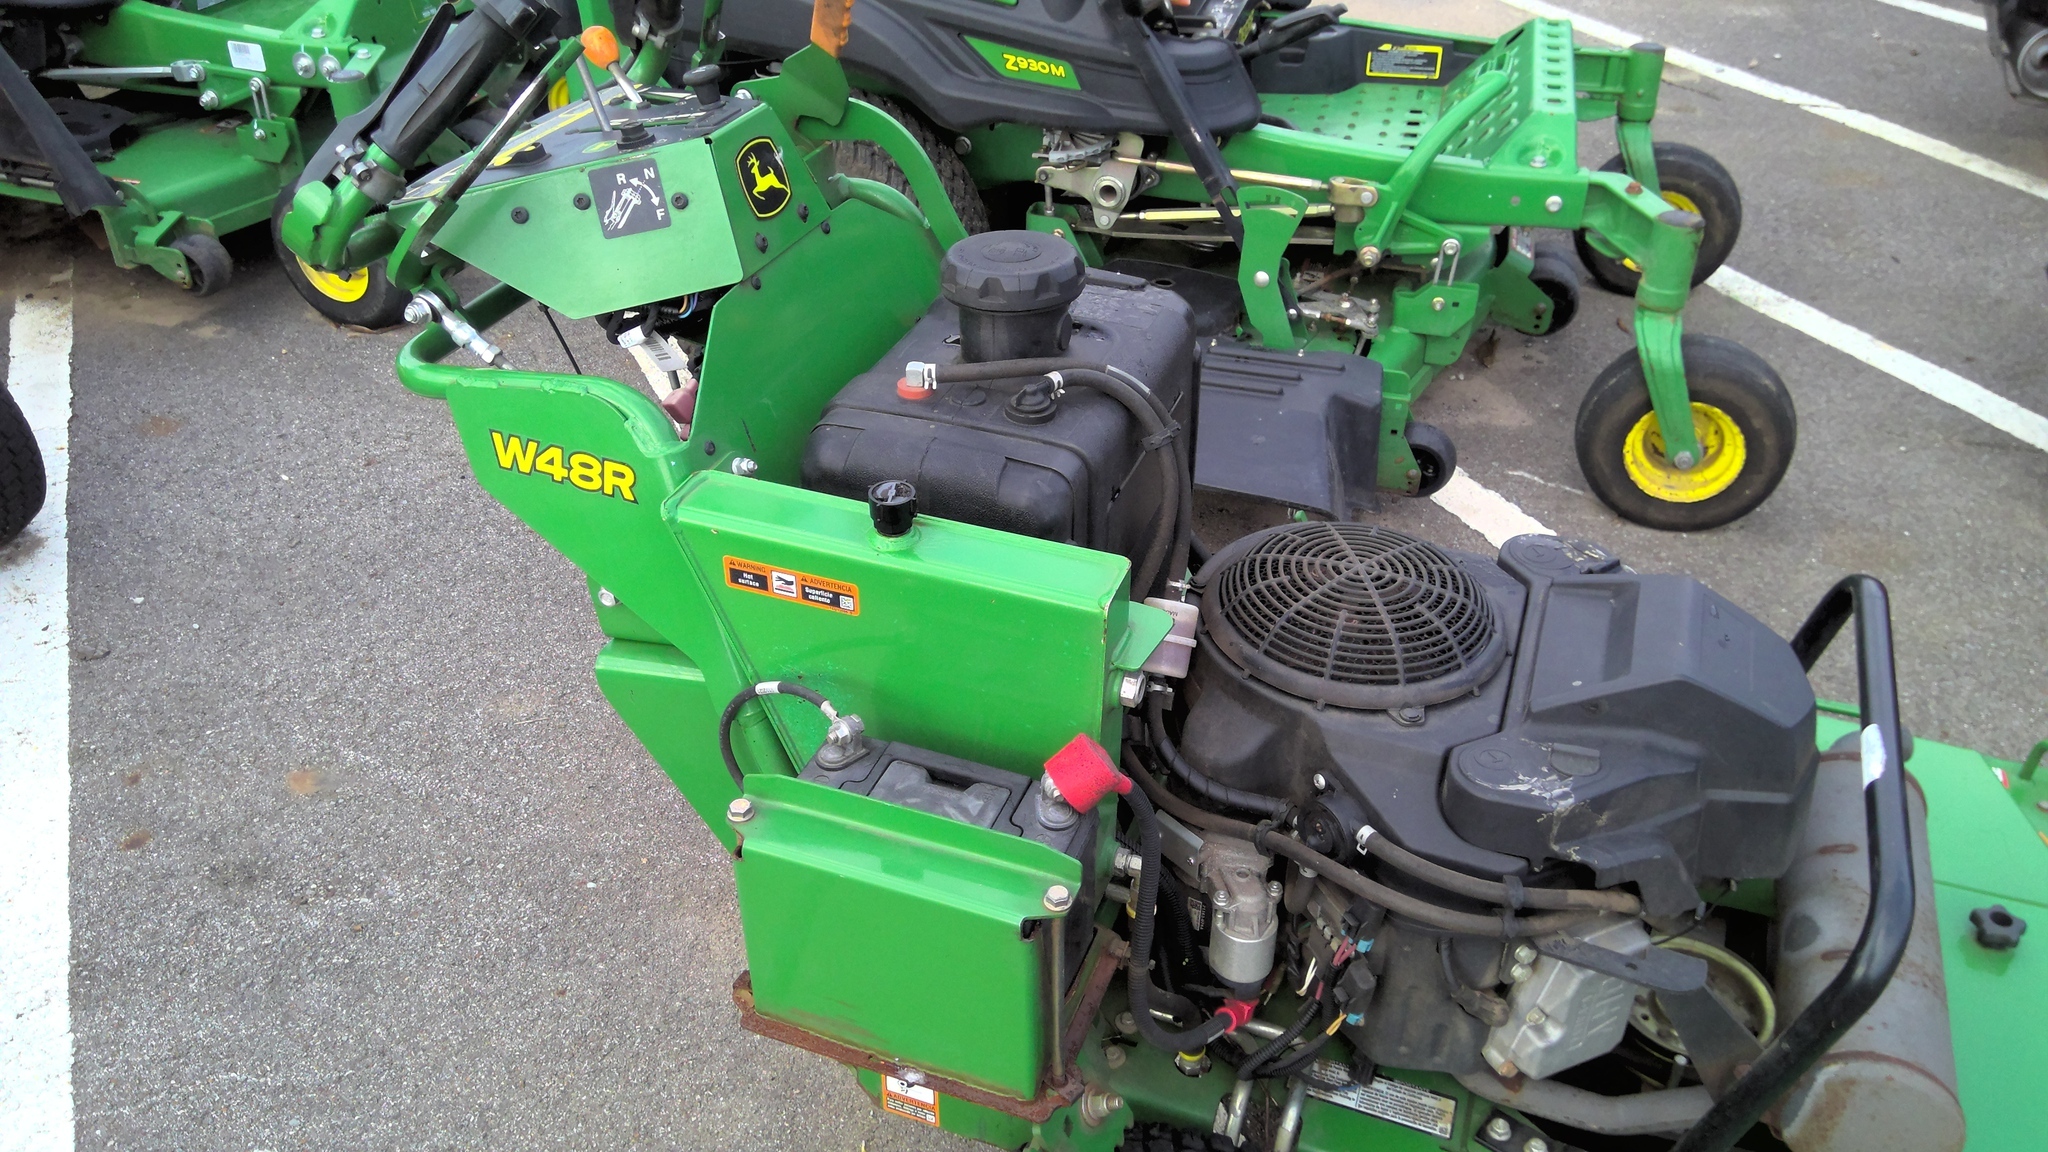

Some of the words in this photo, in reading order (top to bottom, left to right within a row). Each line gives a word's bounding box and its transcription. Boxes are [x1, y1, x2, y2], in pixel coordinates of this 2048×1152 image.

[1002, 53, 1066, 78] Z930M
[616, 173, 627, 185] R
[643, 167, 656, 180] N
[656, 208, 665, 221] F
[490, 430, 637, 503] W48R
[736, 561, 766, 573] WARNING
[738, 578, 760, 587] surface
[743, 572, 754, 580] Hot
[809, 578, 852, 593] ADVERTENCIA
[804, 586, 833, 599] Superficie
[808, 594, 831, 604] caliente
